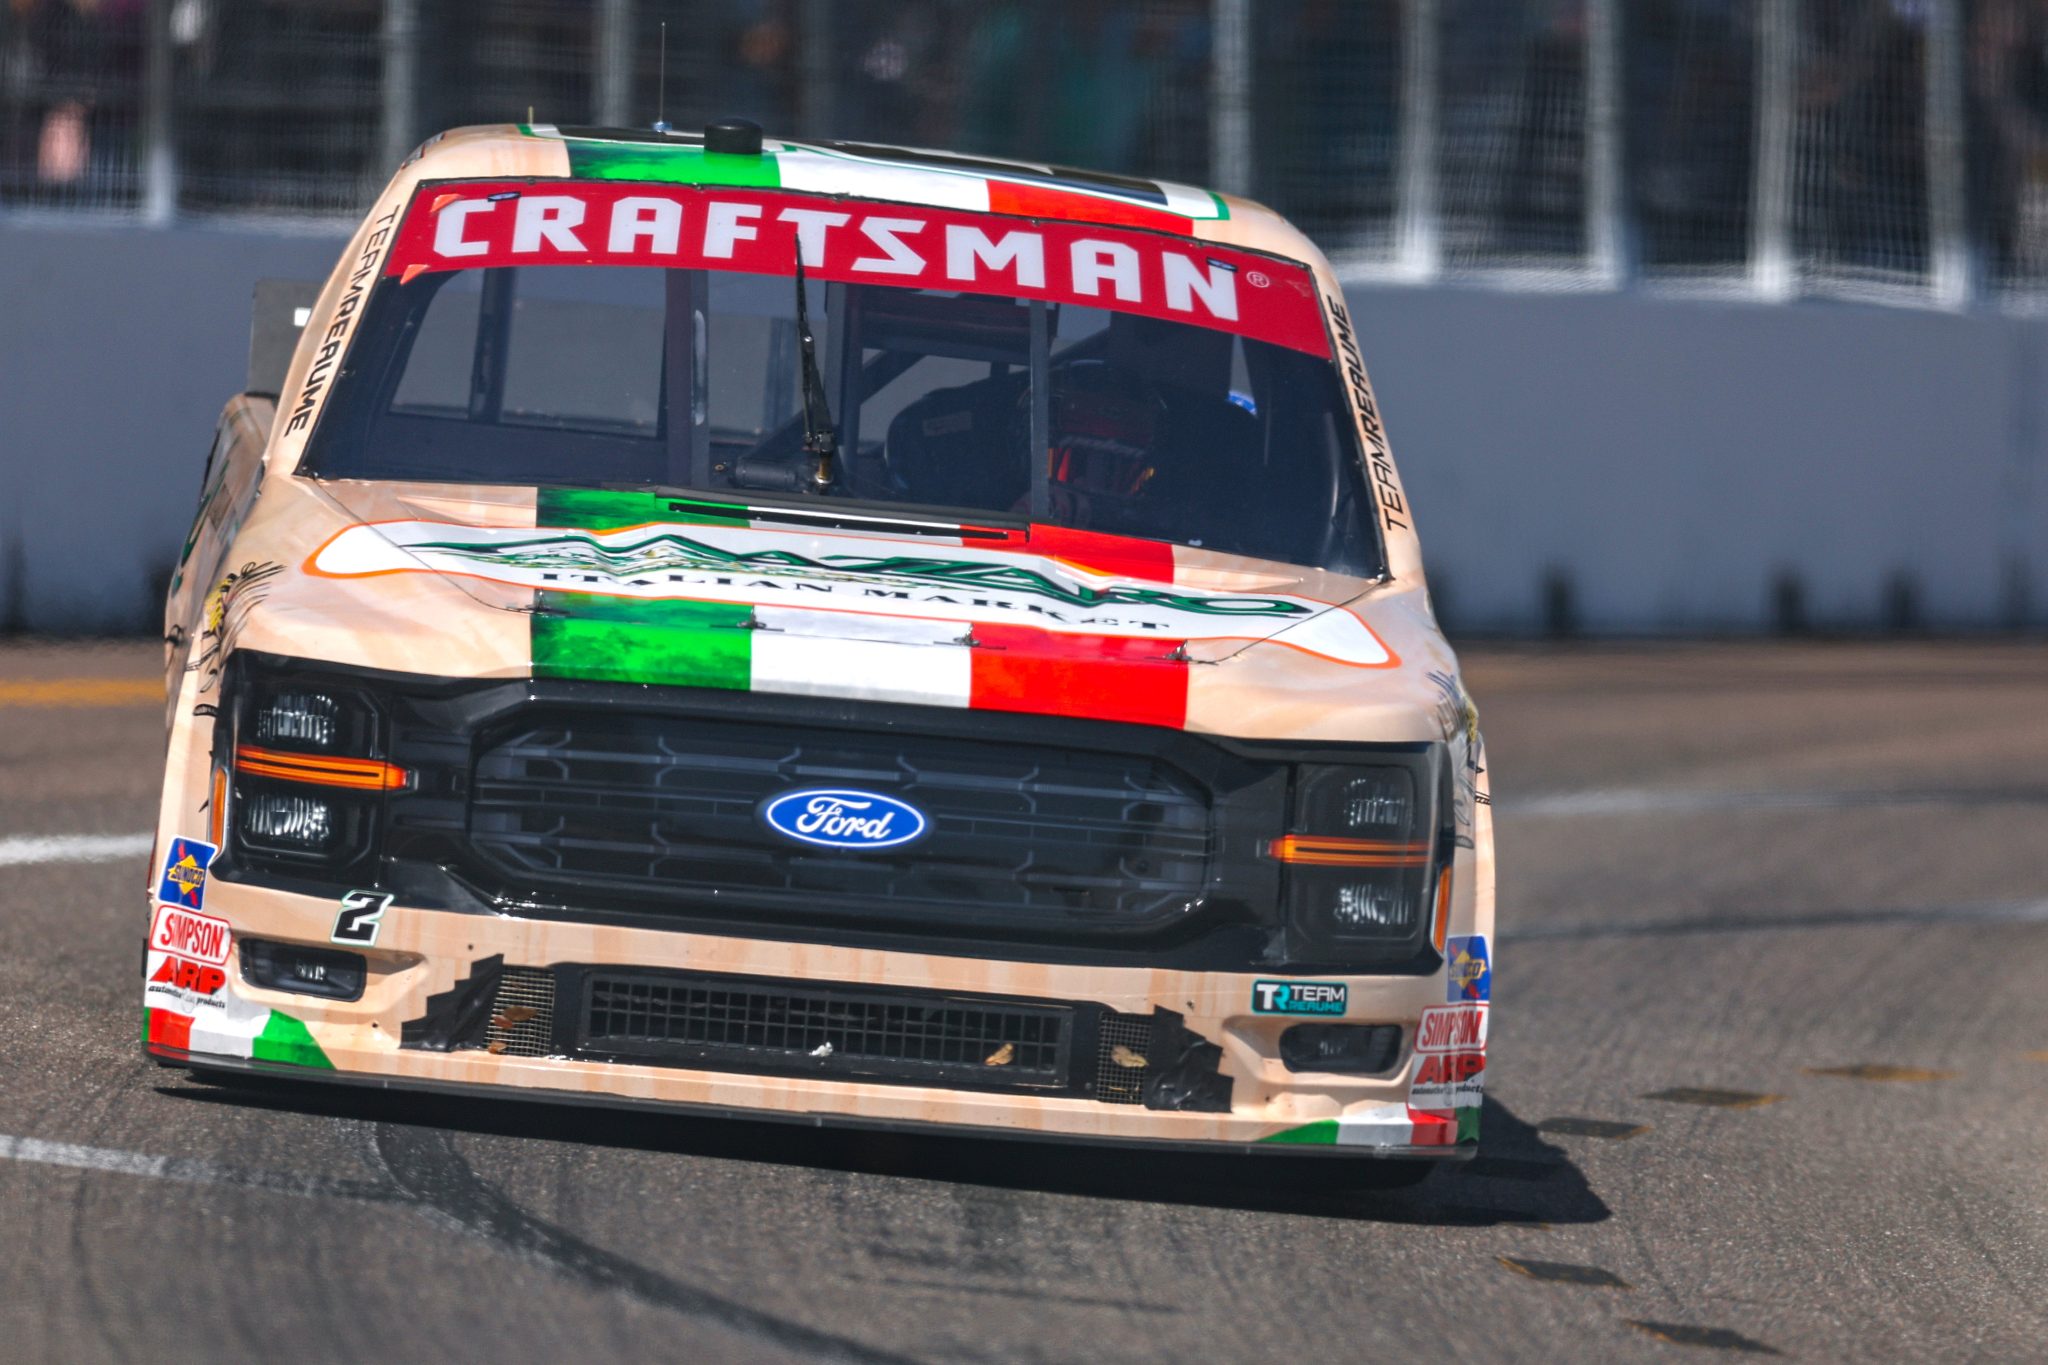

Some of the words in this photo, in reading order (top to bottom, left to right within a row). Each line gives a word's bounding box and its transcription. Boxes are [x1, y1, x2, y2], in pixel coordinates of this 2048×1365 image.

[432, 194, 1239, 321] CRAFTSMAN
[542, 570, 832, 593] ITALIAN
[864, 588, 1171, 630] MARKET
[796, 796, 895, 839] Ford
[160, 913, 225, 958] SIMPSON
[331, 890, 394, 947] 2
[149, 955, 226, 996] ARP
[1290, 985, 1345, 1003] TEAM
[1421, 1011, 1483, 1047] SIMPSON
